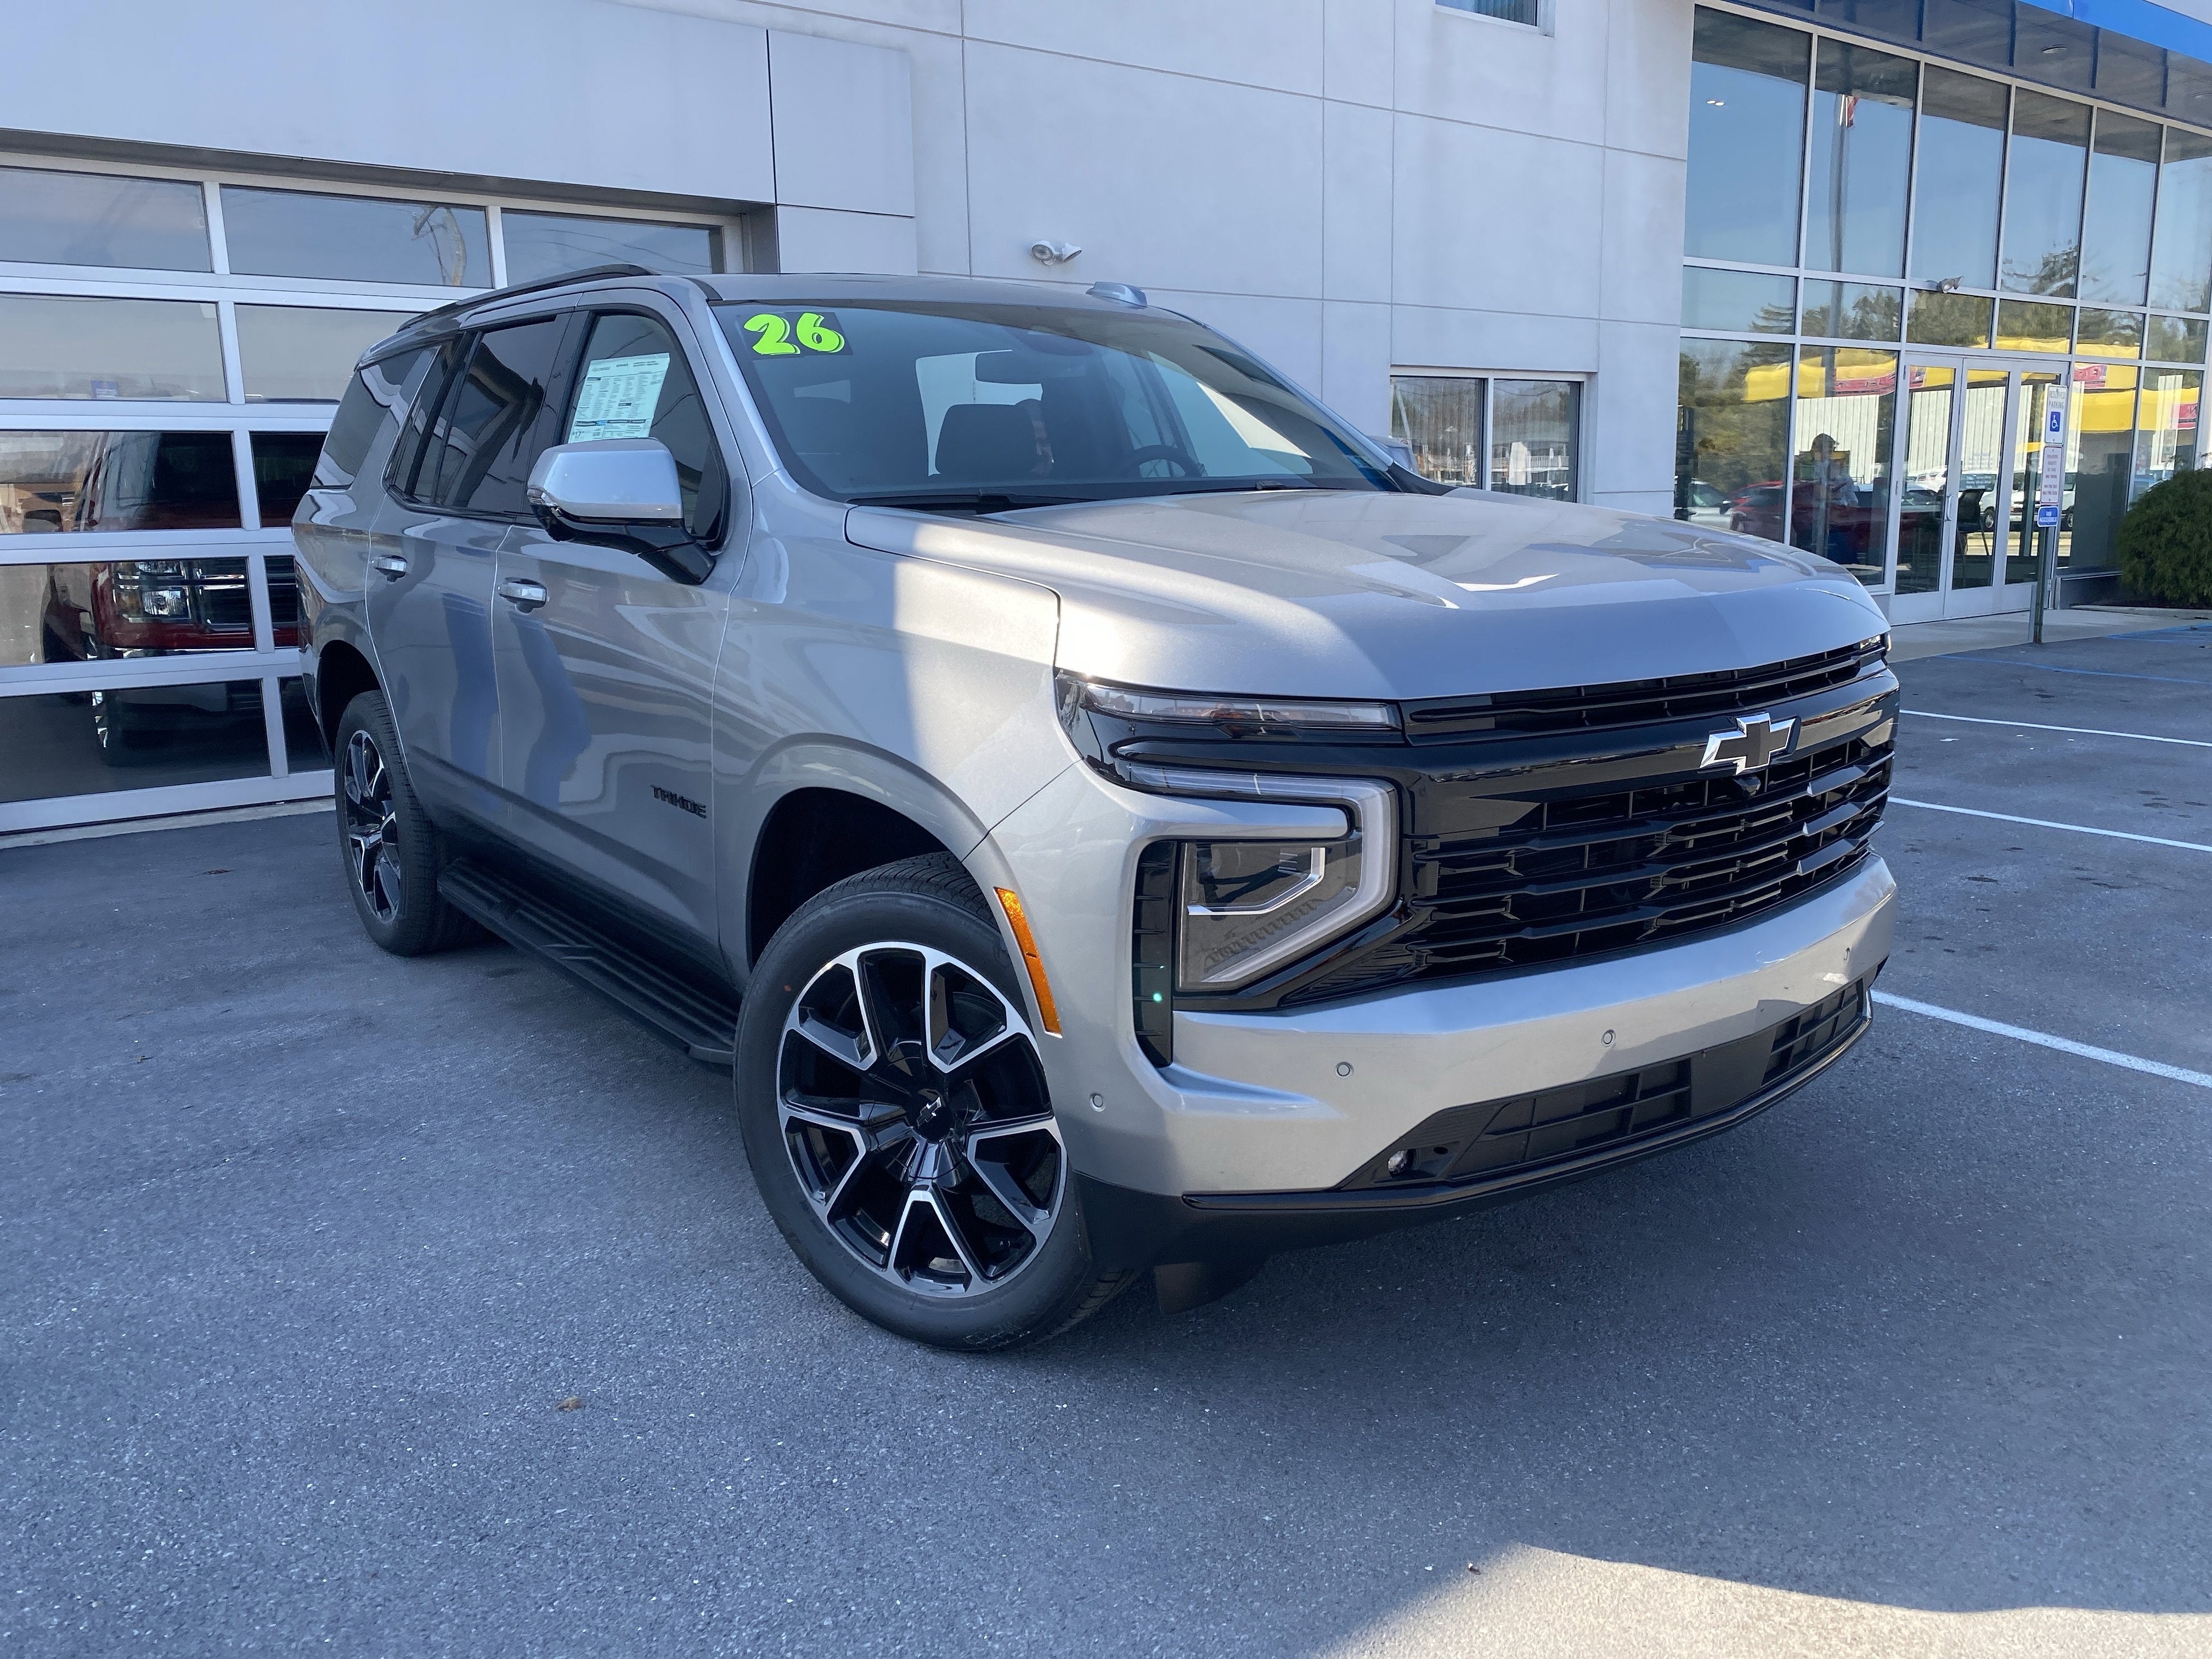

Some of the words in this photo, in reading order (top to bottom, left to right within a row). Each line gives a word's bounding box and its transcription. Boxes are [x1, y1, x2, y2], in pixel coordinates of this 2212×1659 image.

[743, 312, 845, 355] 26
[2049, 391, 2066, 399] RESERVED
[2049, 400, 2064, 409] PARKING
[650, 784, 707, 819] TAHOE
